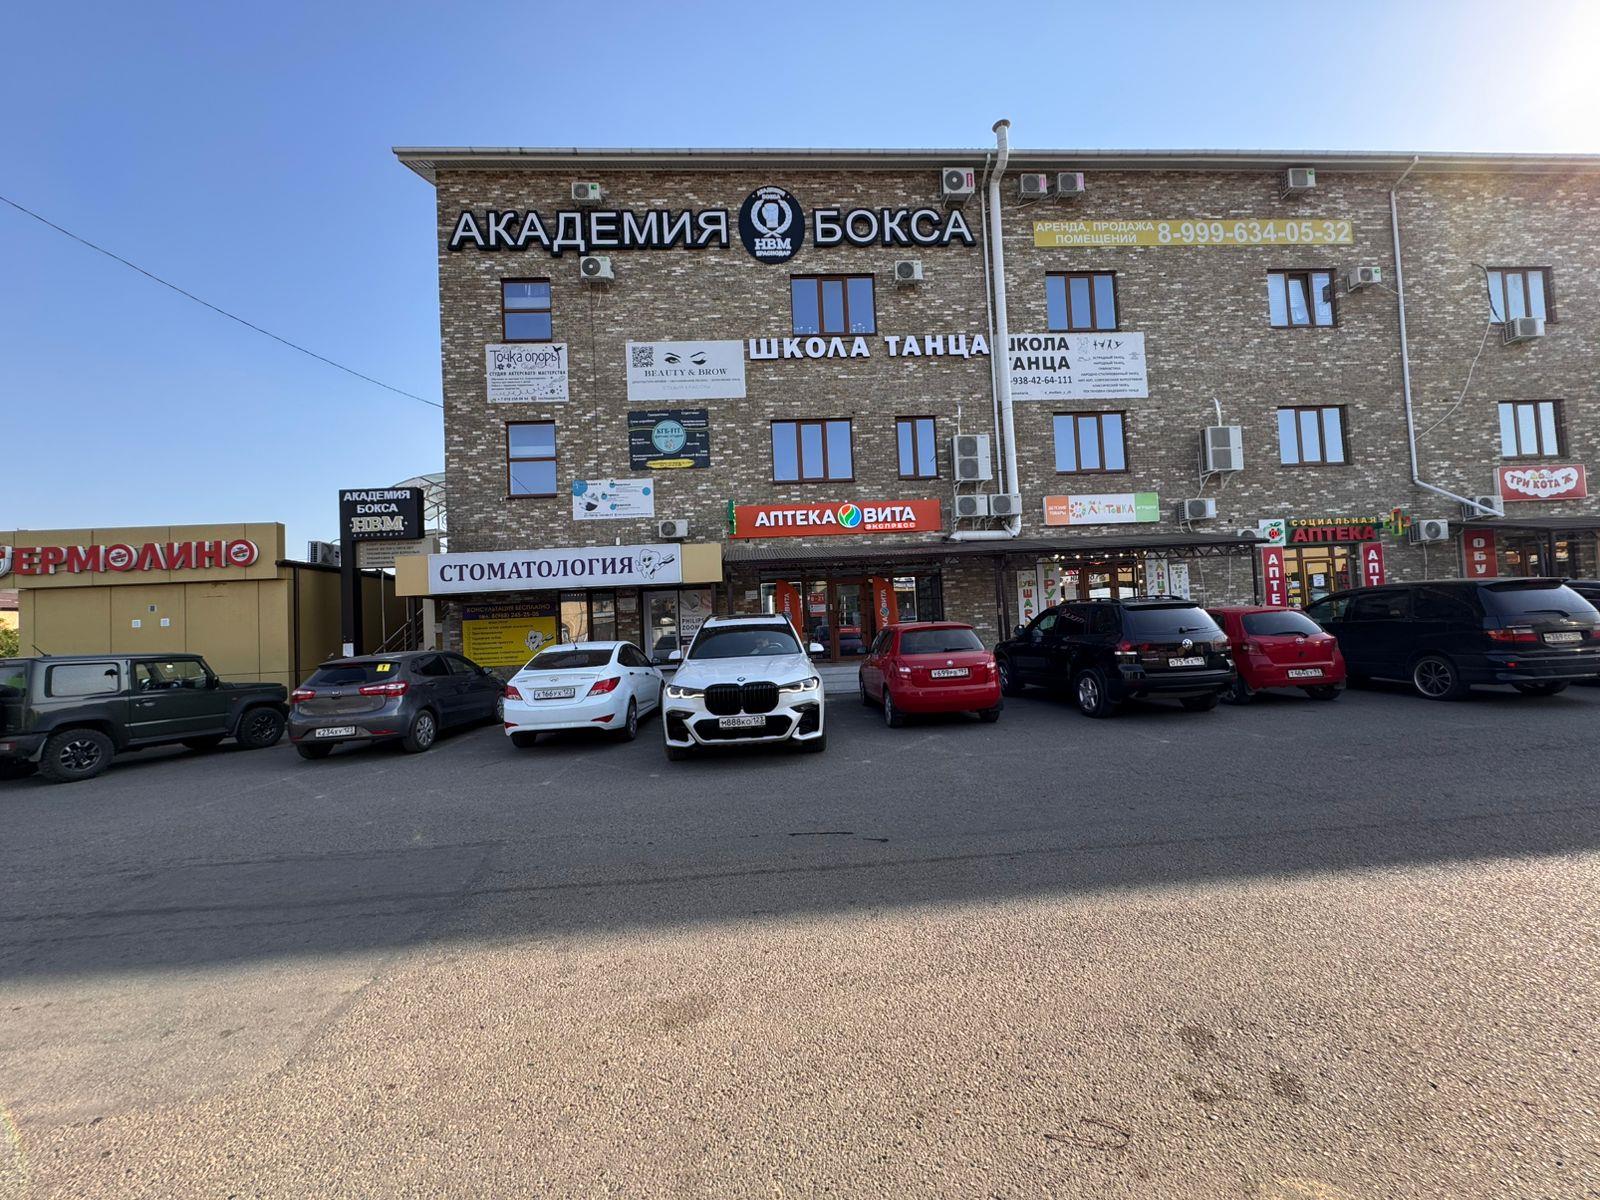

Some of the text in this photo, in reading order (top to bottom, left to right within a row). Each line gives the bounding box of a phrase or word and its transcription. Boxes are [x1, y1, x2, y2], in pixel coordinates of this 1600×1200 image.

[449, 208, 975, 254] АКАДЕМИЯ БОКСА
[1035, 221, 1154, 233] АРЕНДА, ПРОДАЖА
[1157, 221, 1351, 243] 8-999-634-05-32
[1055, 232, 1137, 244] ПОМЕЩЕНИЙ
[749, 334, 990, 359] ШКОЛА ТАНЦА
[489, 350, 560, 370] Точка опоры
[1008, 355, 1071, 373] АНЦА
[644, 369, 686, 377] BEAUTY
[698, 368, 728, 376] BROW
[1509, 474, 1560, 489] ТРИ КОТА
[344, 490, 411, 501] АКАДЕМИЯ
[356, 503, 399, 513] БОКСА
[755, 507, 917, 527] АПТЕКА ВИТА
[1291, 516, 1377, 527] СОЦИАЛЬНАЯ
[864, 522, 917, 530] ЭКСПРЕСС
[1292, 526, 1377, 543] АПТЕКА
[14, 539, 258, 575] ЕРМОЛИНО
[439, 556, 634, 582] СТОМАТОЛОГИЯ
[466, 603, 551, 613] КОНСУЛЬТАЦИЯ БЕСПЛАТНО
